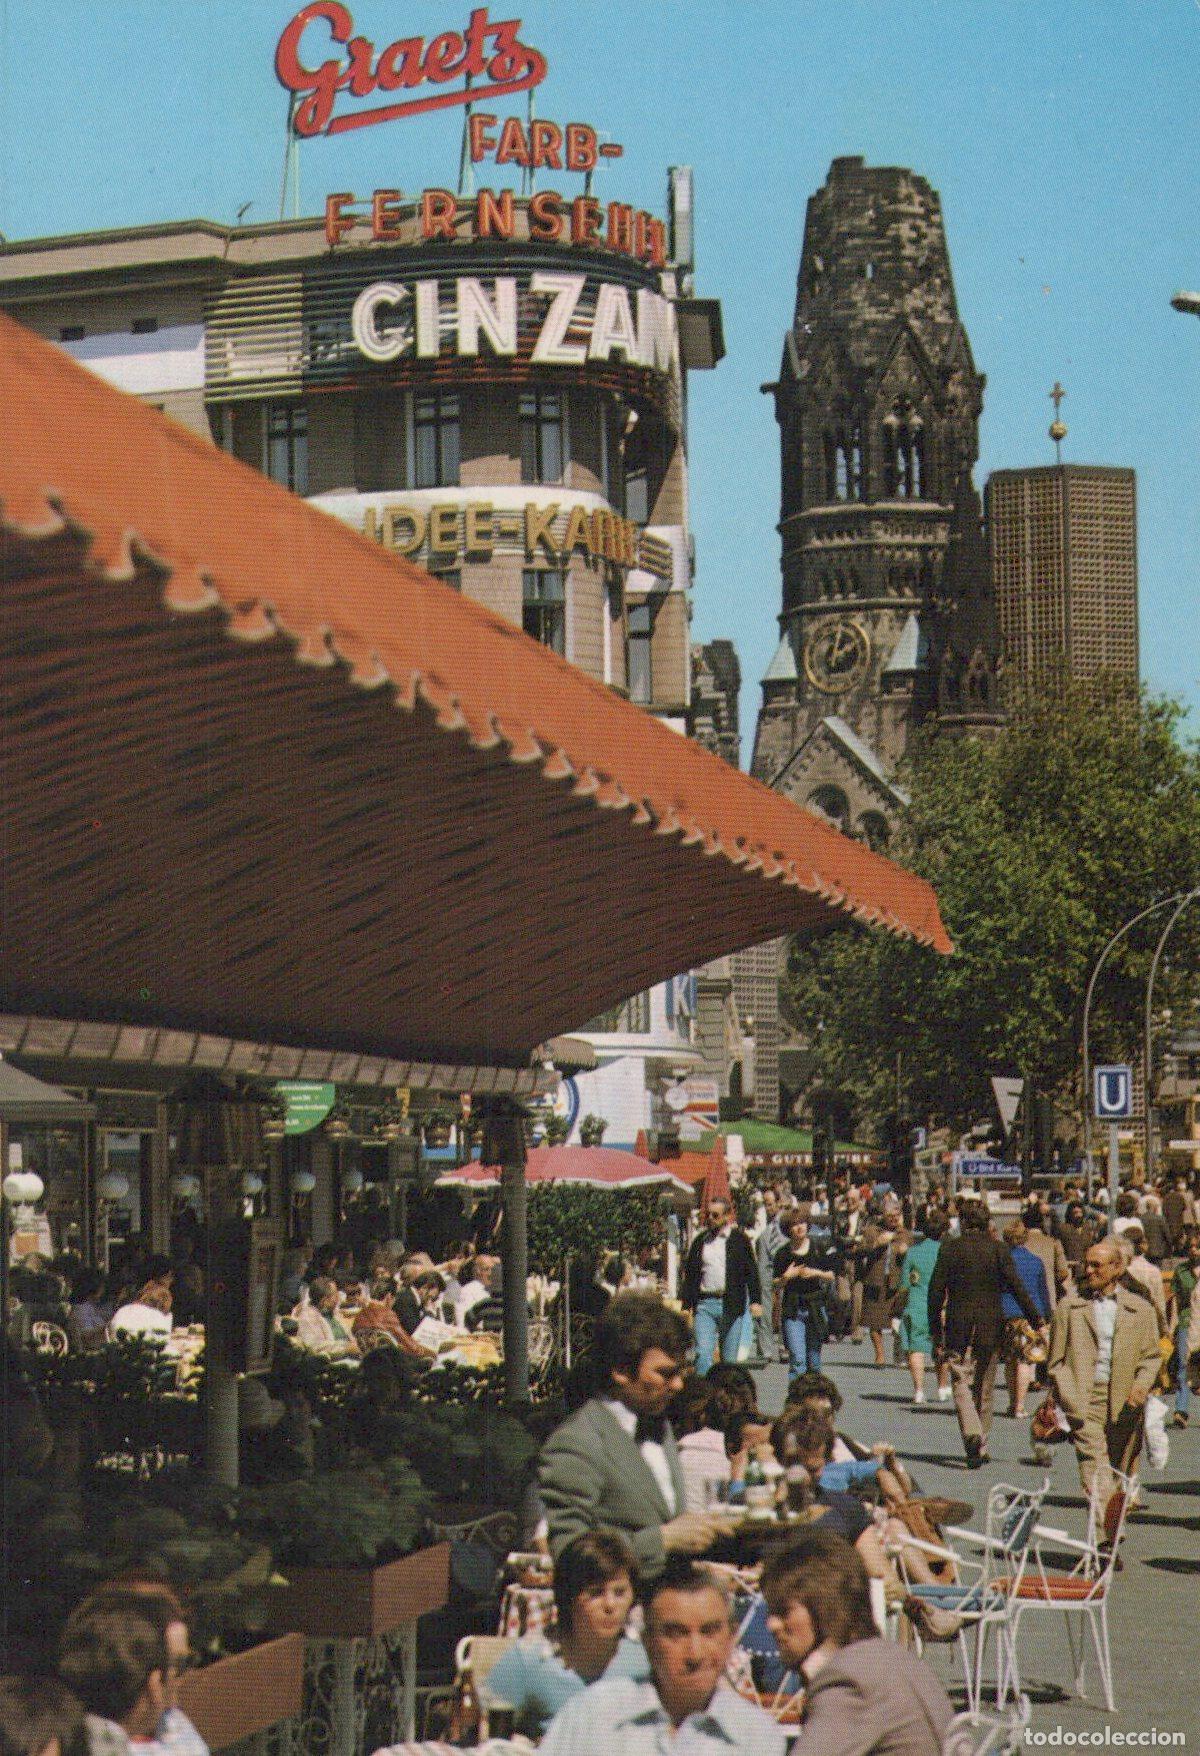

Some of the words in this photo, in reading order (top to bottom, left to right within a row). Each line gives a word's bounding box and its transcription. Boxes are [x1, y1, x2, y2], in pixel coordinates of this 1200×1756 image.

[275, 1, 547, 138] Graetz
[469, 113, 624, 173] FARB-
[1100, 1074, 1127, 1112] U
